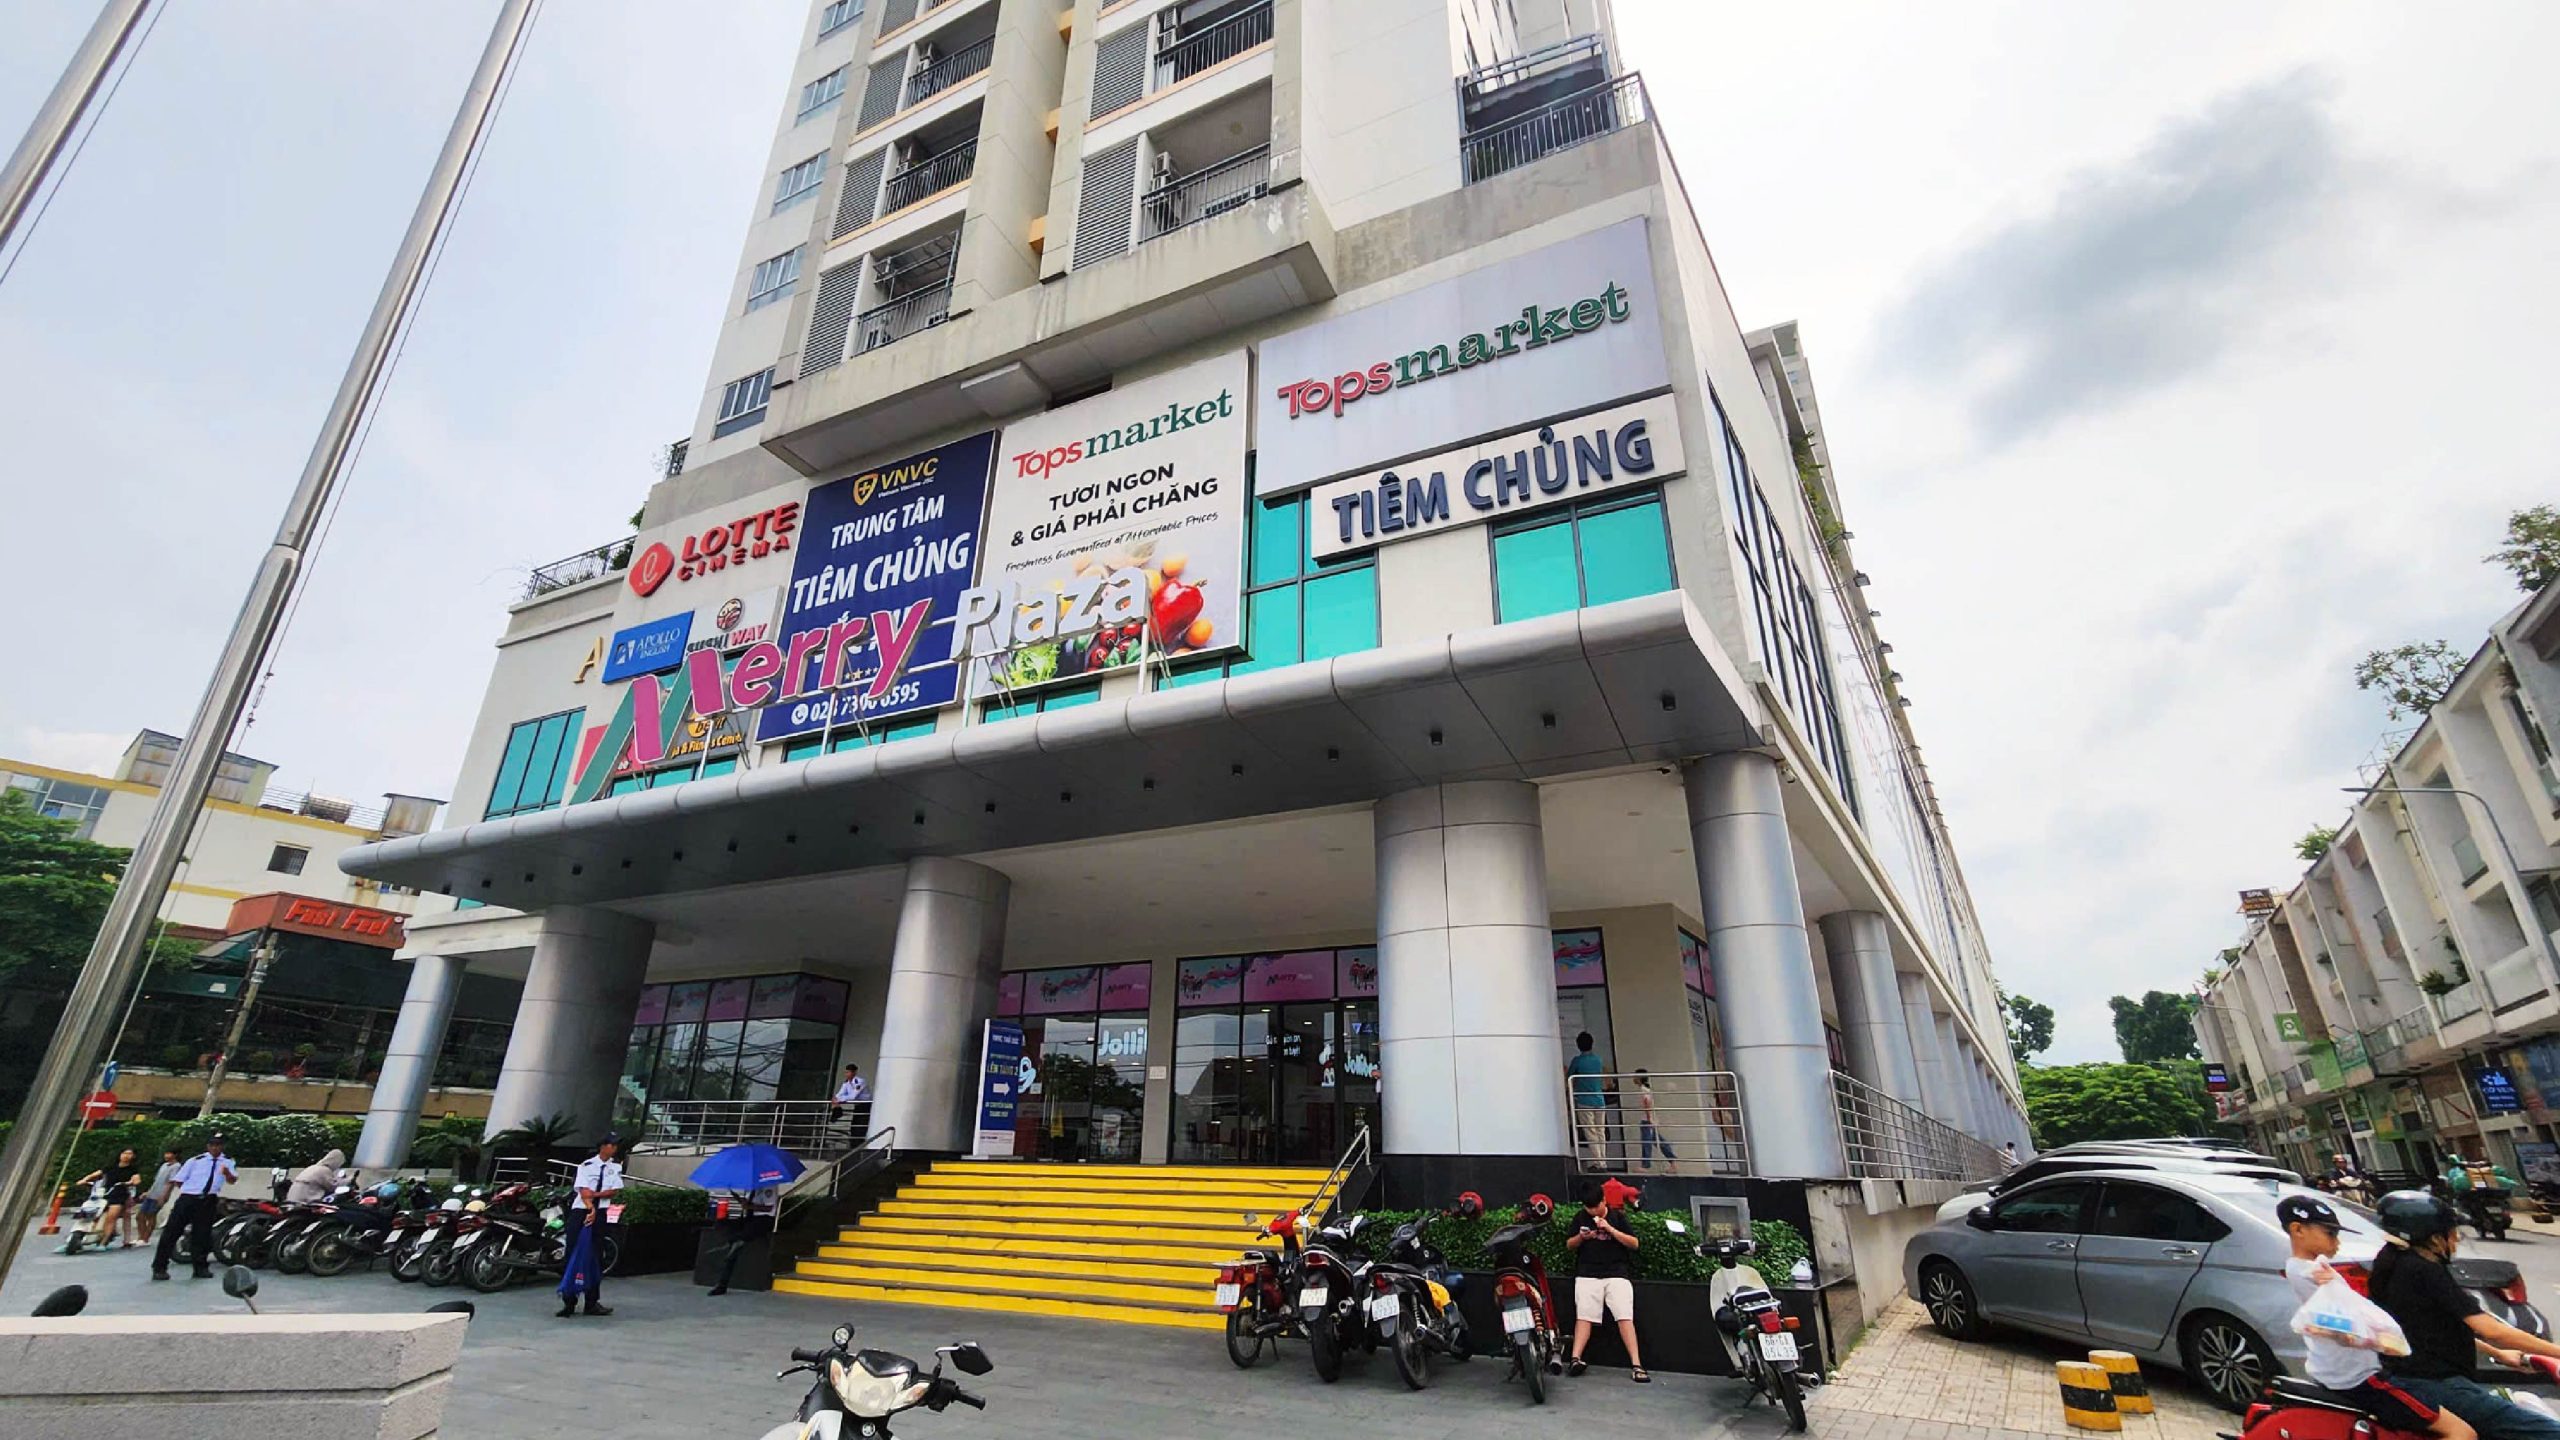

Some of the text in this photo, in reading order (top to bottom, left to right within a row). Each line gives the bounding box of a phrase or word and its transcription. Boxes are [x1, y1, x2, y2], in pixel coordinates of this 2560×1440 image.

[881, 457, 939, 490] VNVC
[1049, 462, 1174, 511] TƯƠI NGON
[1332, 419, 1655, 544] TIÊM CHỦNG
[681, 502, 799, 563] LOTTE
[831, 494, 945, 549] TRUNG TÂM
[1011, 477, 1218, 547] & GIÁ PHẢI CHĂNG
[677, 534, 790, 582] CINEMA
[792, 532, 971, 613] TIÊM CHỦNG
[636, 627, 682, 650] APOLLO
[731, 623, 768, 646] WAY
[573, 568, 1148, 803] Merry Plaza
